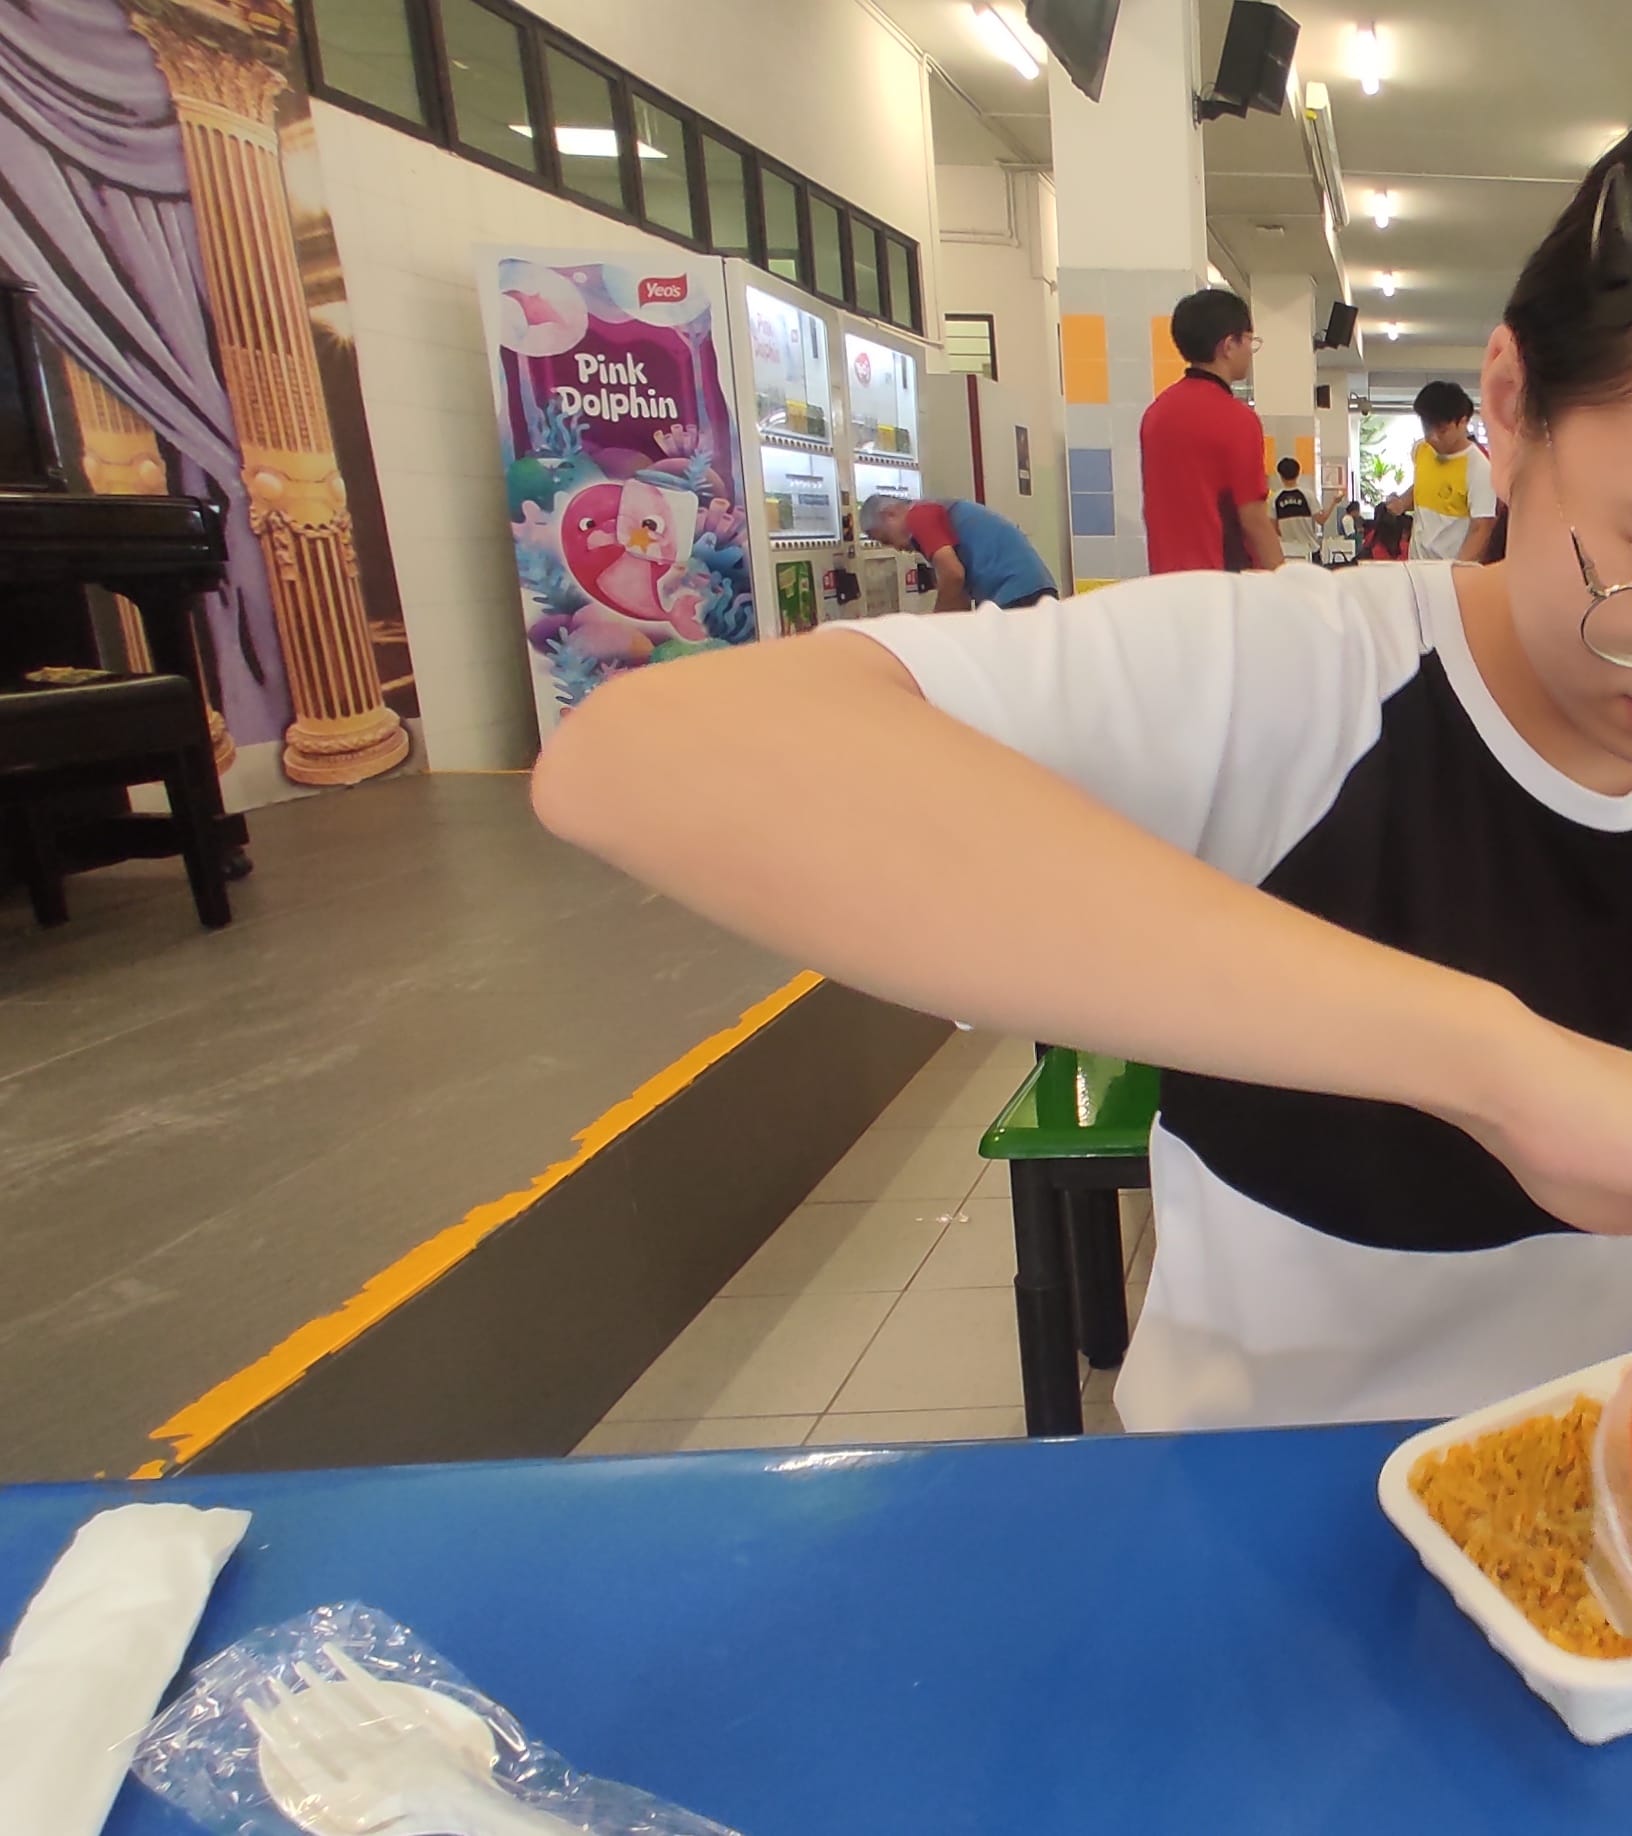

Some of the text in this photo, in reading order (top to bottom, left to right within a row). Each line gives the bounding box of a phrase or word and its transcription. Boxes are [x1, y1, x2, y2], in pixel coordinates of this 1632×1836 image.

[646, 282, 682, 298] Yeo's
[574, 352, 648, 385] Pink
[556, 386, 678, 422] Dolphin
